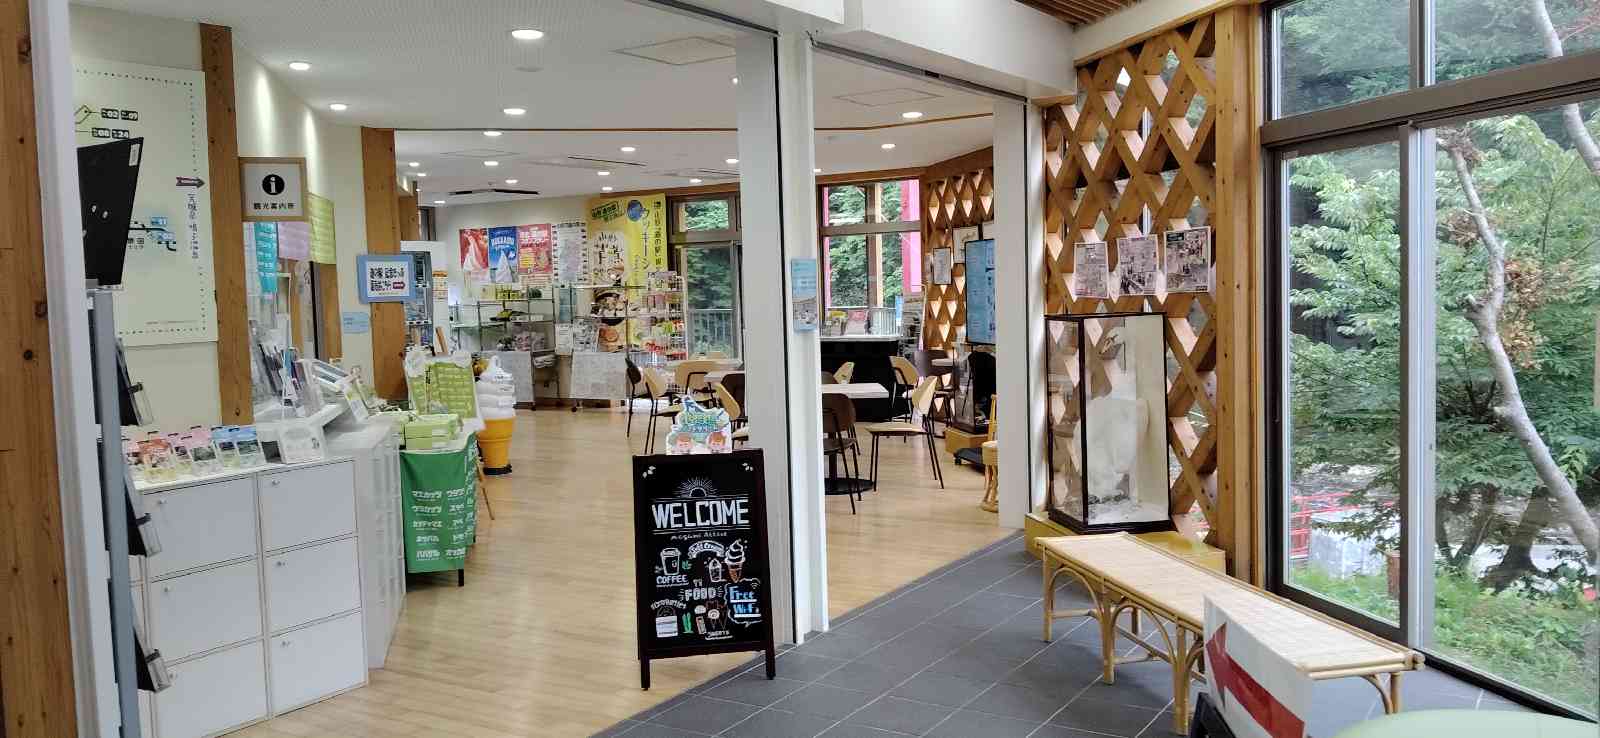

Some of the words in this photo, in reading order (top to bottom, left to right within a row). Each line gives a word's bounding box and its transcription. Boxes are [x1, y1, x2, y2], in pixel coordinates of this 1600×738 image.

[253, 202, 297, 210] 観光案内所
[651, 499, 750, 529] WELCOME
[656, 574, 688, 585] COFFEE
[684, 587, 717, 602] FOOD
[729, 585, 755, 600] Free
